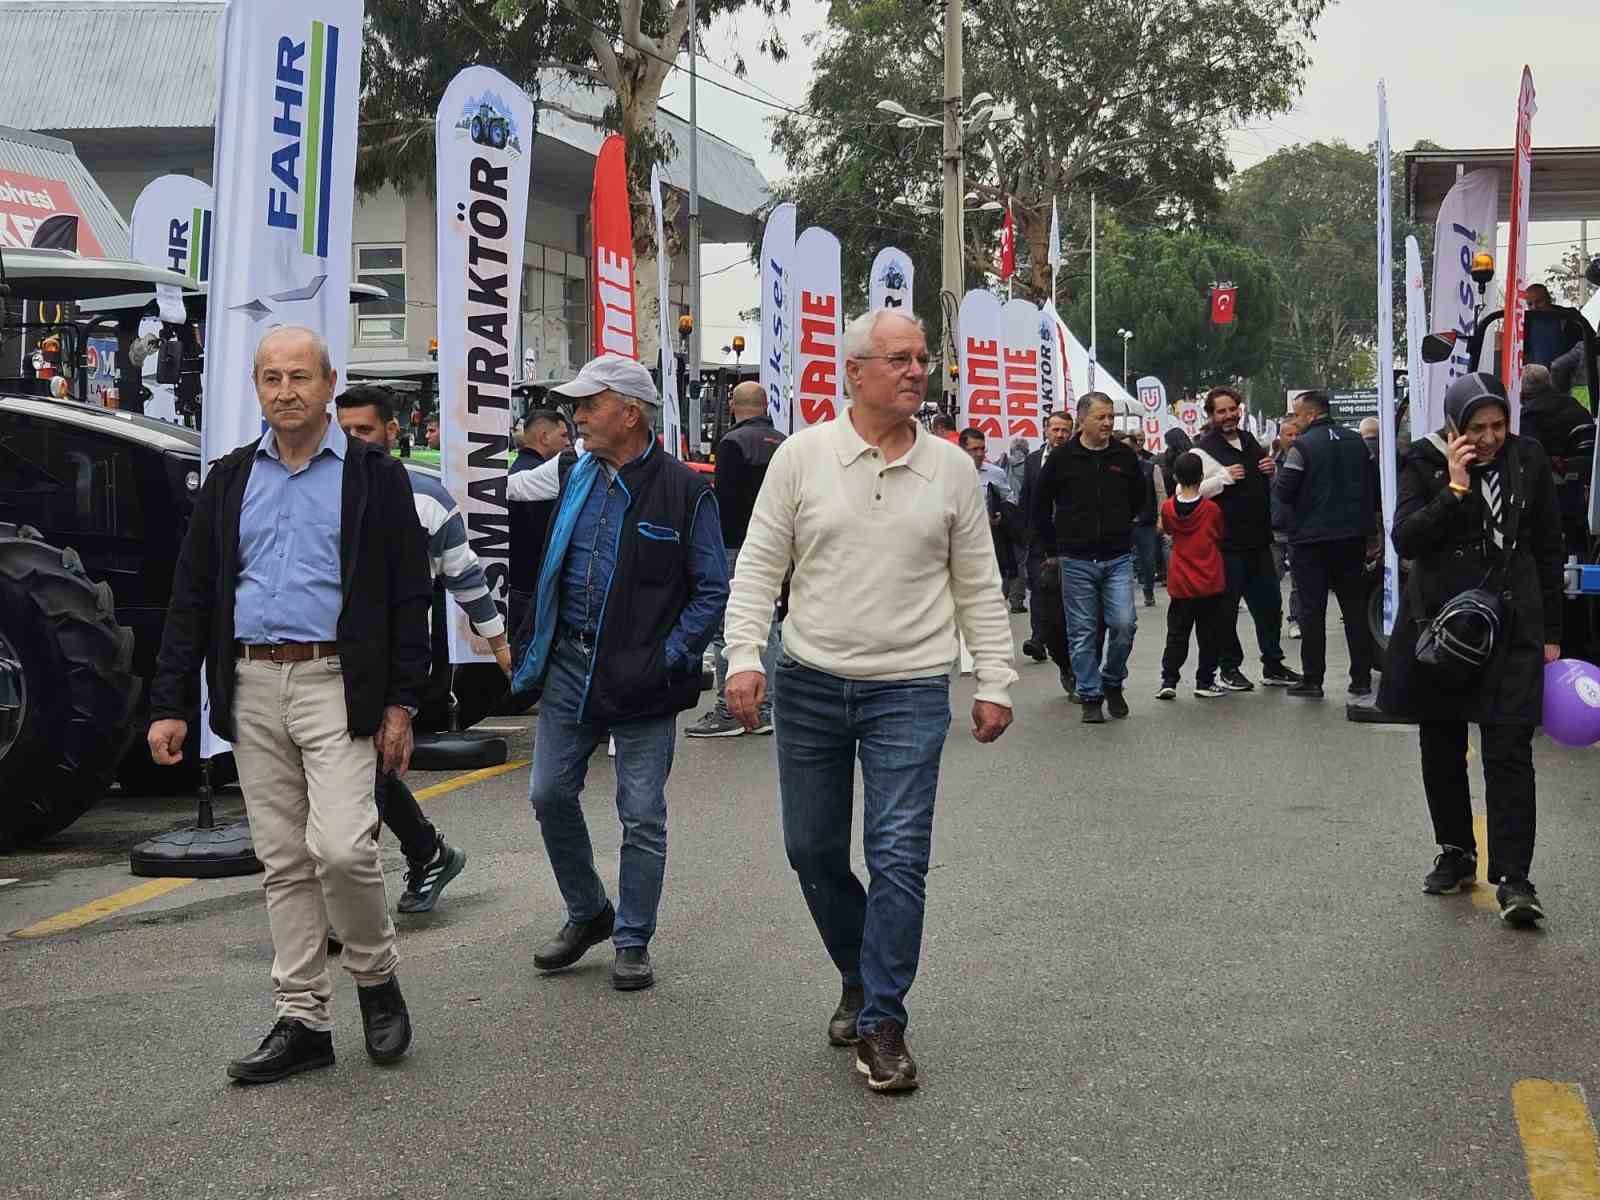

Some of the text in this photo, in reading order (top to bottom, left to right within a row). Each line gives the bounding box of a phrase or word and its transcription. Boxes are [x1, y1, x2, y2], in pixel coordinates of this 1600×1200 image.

[267, 35, 306, 231] FAHR
[167, 217, 189, 275] HR
[597, 246, 636, 358] ME
[457, 156, 511, 637] SMAN TRAKTÖR
[769, 257, 785, 414] üksel
[800, 290, 836, 425] SAME
[966, 336, 1003, 439] SAME
[1003, 347, 1039, 439] SAME
